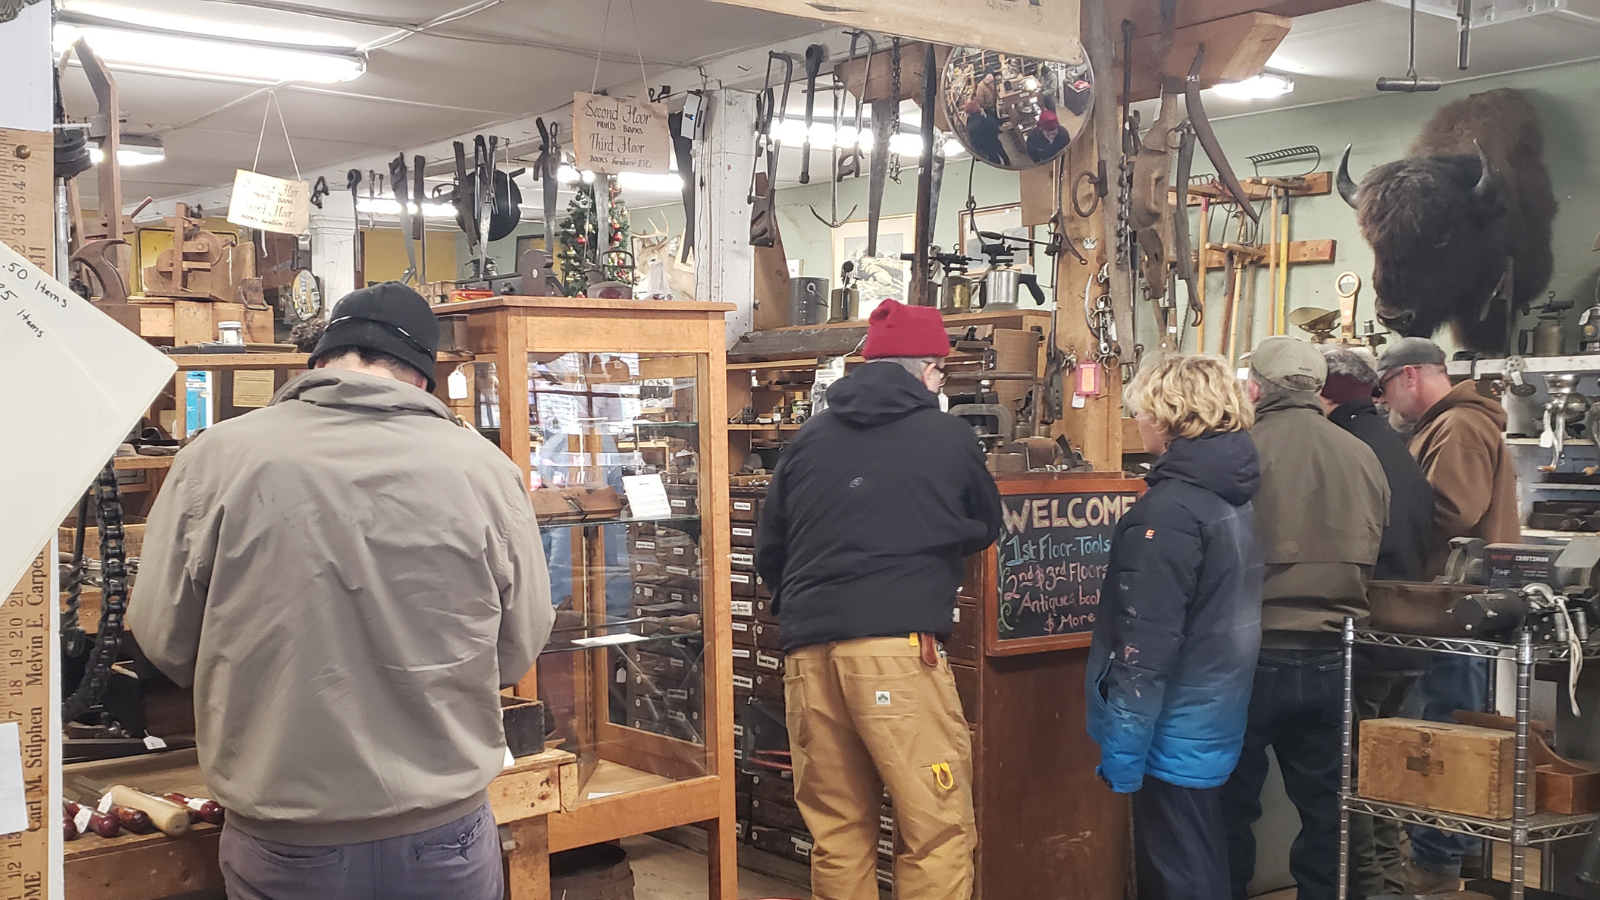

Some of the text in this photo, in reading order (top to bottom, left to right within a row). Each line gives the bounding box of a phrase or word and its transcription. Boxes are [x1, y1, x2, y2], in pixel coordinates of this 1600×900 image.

[585, 100, 652, 125] Second Floor
[596, 120, 644, 135] PRINTS BOOKS
[589, 132, 645, 154] Third Floor
[589, 154, 608, 164] BOOKS
[1001, 495, 1137, 534] WELCOME
[1005, 534, 1037, 567] 1st
[1515, 555, 1549, 563] CRAFTSMAN
[1004, 565, 1034, 601] 2nd
[1045, 560, 1068, 592] 3rd
[9, 617, 24, 639] 20
[26, 613, 44, 628] E.
[1056, 612, 1097, 632] More
[9, 649, 24, 667] 19
[25, 635, 44, 687] Melvin
[8, 679, 24, 697] 18
[25, 706, 47, 769] Stilphen
[25, 774, 42, 794] M.
[26, 800, 42, 832] Carl
[7, 861, 22, 880] 12
